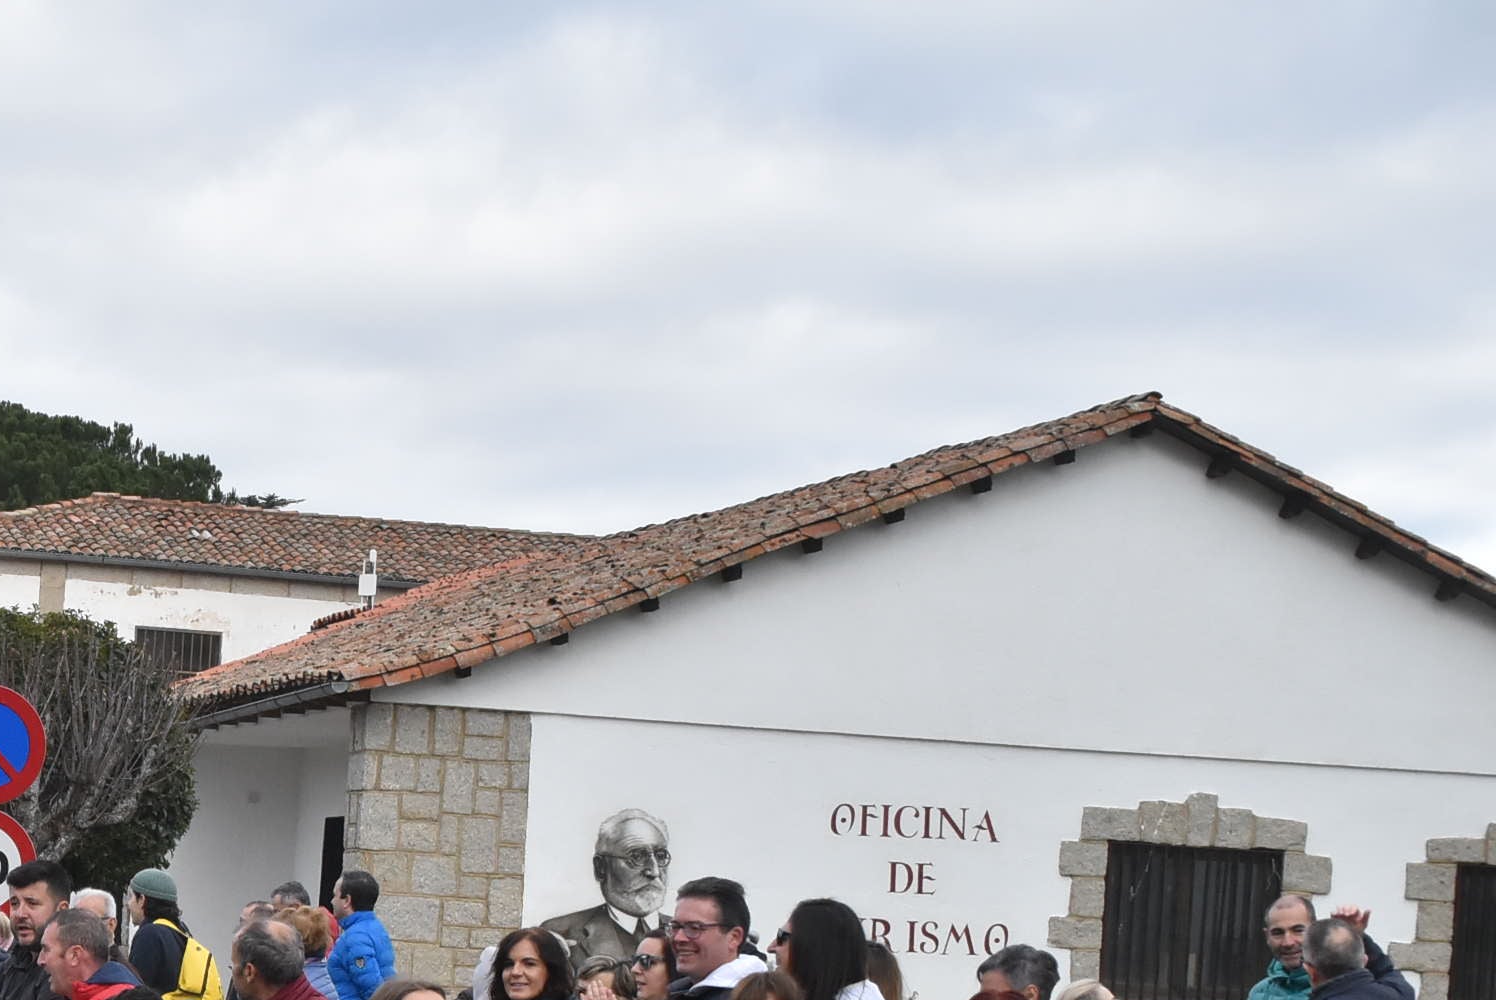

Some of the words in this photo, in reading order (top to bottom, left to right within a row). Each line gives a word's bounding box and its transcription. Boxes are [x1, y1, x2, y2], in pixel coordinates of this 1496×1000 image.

[830, 803, 1000, 843] OFICINA
[887, 861, 936, 895] DE
[857, 917, 1009, 957] RISMO
